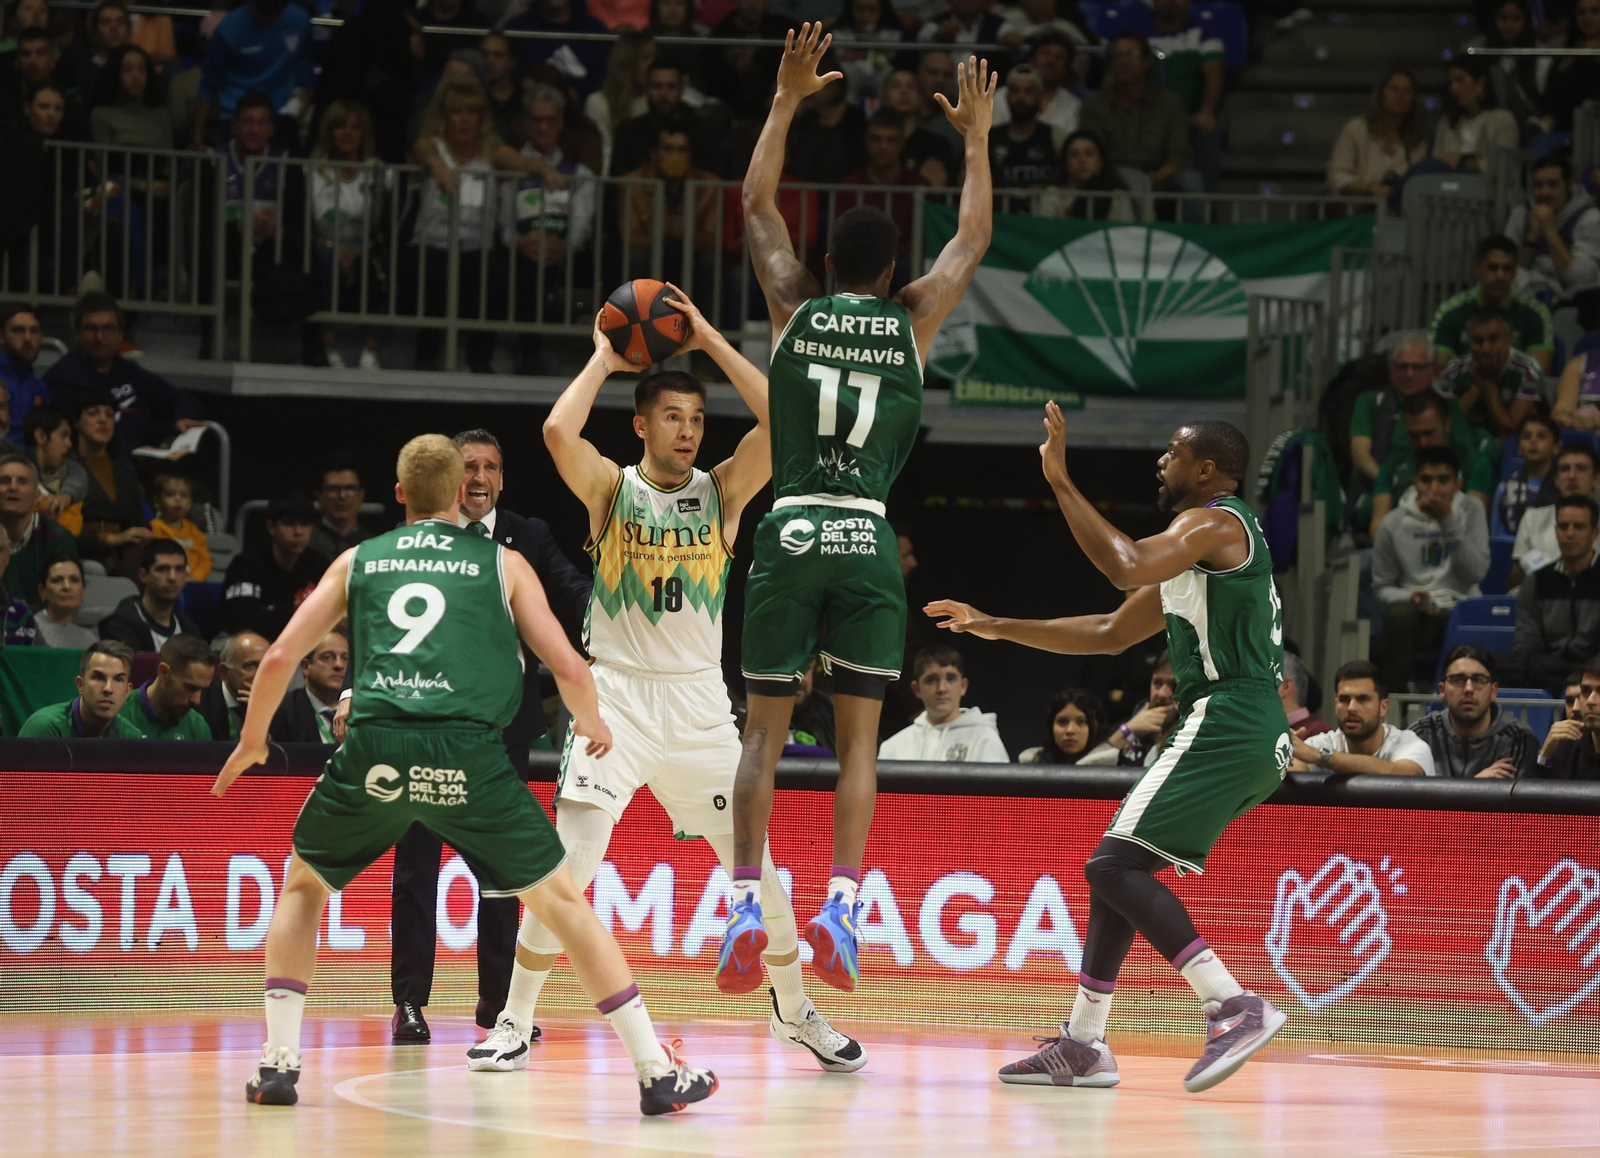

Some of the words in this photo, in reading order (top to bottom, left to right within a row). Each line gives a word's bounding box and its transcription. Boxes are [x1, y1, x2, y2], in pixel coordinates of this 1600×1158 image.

[810, 312, 900, 337] CARTER
[793, 338, 905, 366] BENAHAVÍS
[822, 517, 876, 531] COSTA
[396, 531, 454, 551] DÍAZ
[622, 520, 712, 548] surne
[821, 531, 848, 542] DEL
[850, 531, 877, 543] SOL
[623, 549, 655, 561] eguros
[667, 551, 712, 563] pensiones
[820, 544, 877, 555] MALAGA
[364, 558, 480, 576] BENAHAVÍS
[651, 576, 683, 612] 19
[387, 582, 446, 654] 9
[371, 669, 454, 692] Andalucía
[409, 765, 467, 782] COSTA
[408, 781, 436, 794] DEL
[438, 783, 468, 795] SOL
[409, 791, 468, 806] MÁLAGA
[0, 850, 199, 956] OSTA
[225, 853, 366, 951] DL
[593, 860, 1083, 973] MAAGA
